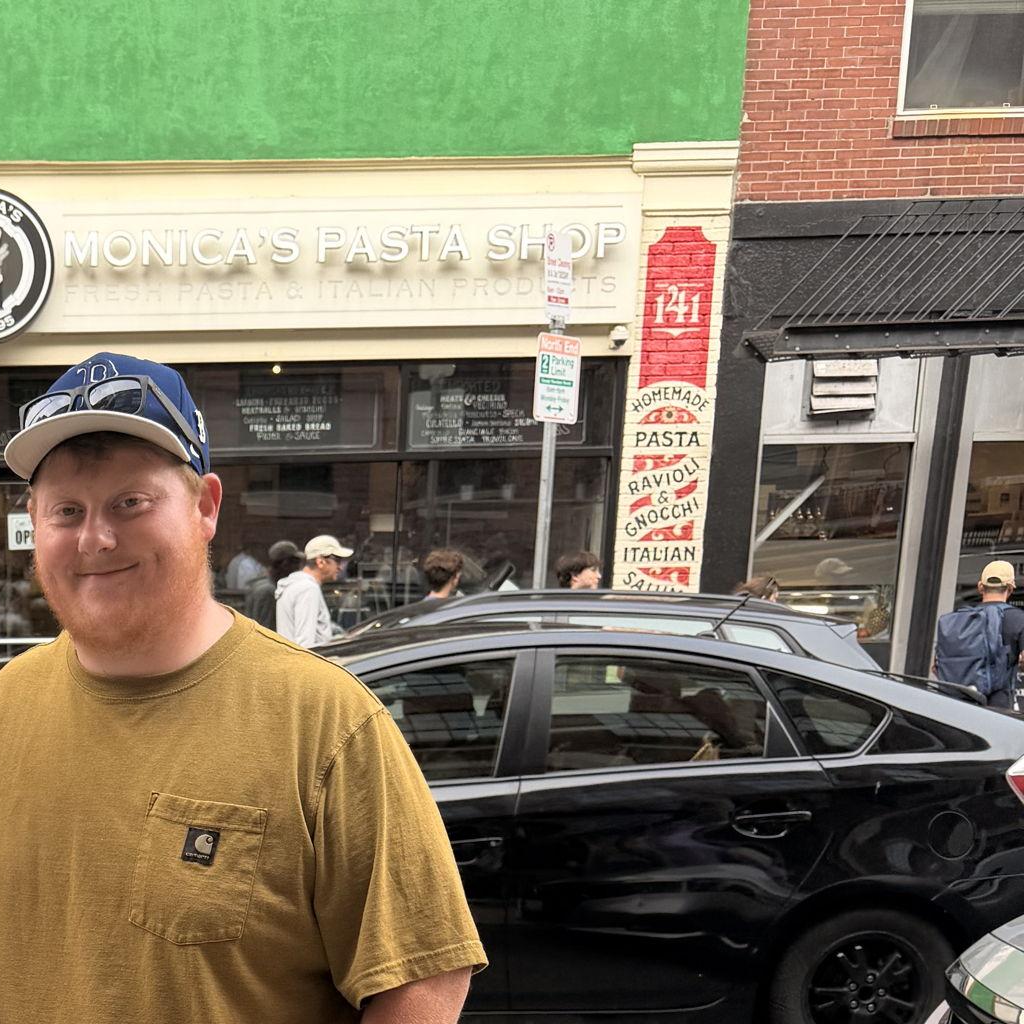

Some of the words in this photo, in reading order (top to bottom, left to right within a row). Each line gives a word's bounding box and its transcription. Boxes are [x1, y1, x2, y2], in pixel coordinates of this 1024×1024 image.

[63, 227, 301, 268] MONICA'S
[316, 223, 471, 263] PASTA
[487, 222, 626, 261] SHOP
[63, 283, 163, 303] FRESH
[177, 281, 273, 302] PASTA
[286, 281, 304, 300] &
[318, 278, 436, 299] ITALIAN
[452, 275, 617, 298] PRODTS
[653, 285, 701, 324] 141
[542, 354, 549, 369] 2
[552, 355, 574, 369] Parking
[551, 365, 566, 376] Limit
[632, 387, 709, 413] HOMEMADE
[635, 431, 700, 447] PASTA
[628, 457, 700, 495] RAVIOLI
[657, 490, 669, 504] &
[625, 497, 699, 537] GNOCCHI
[15, 530, 35, 545] OP
[623, 546, 696, 562] ITALIAN
